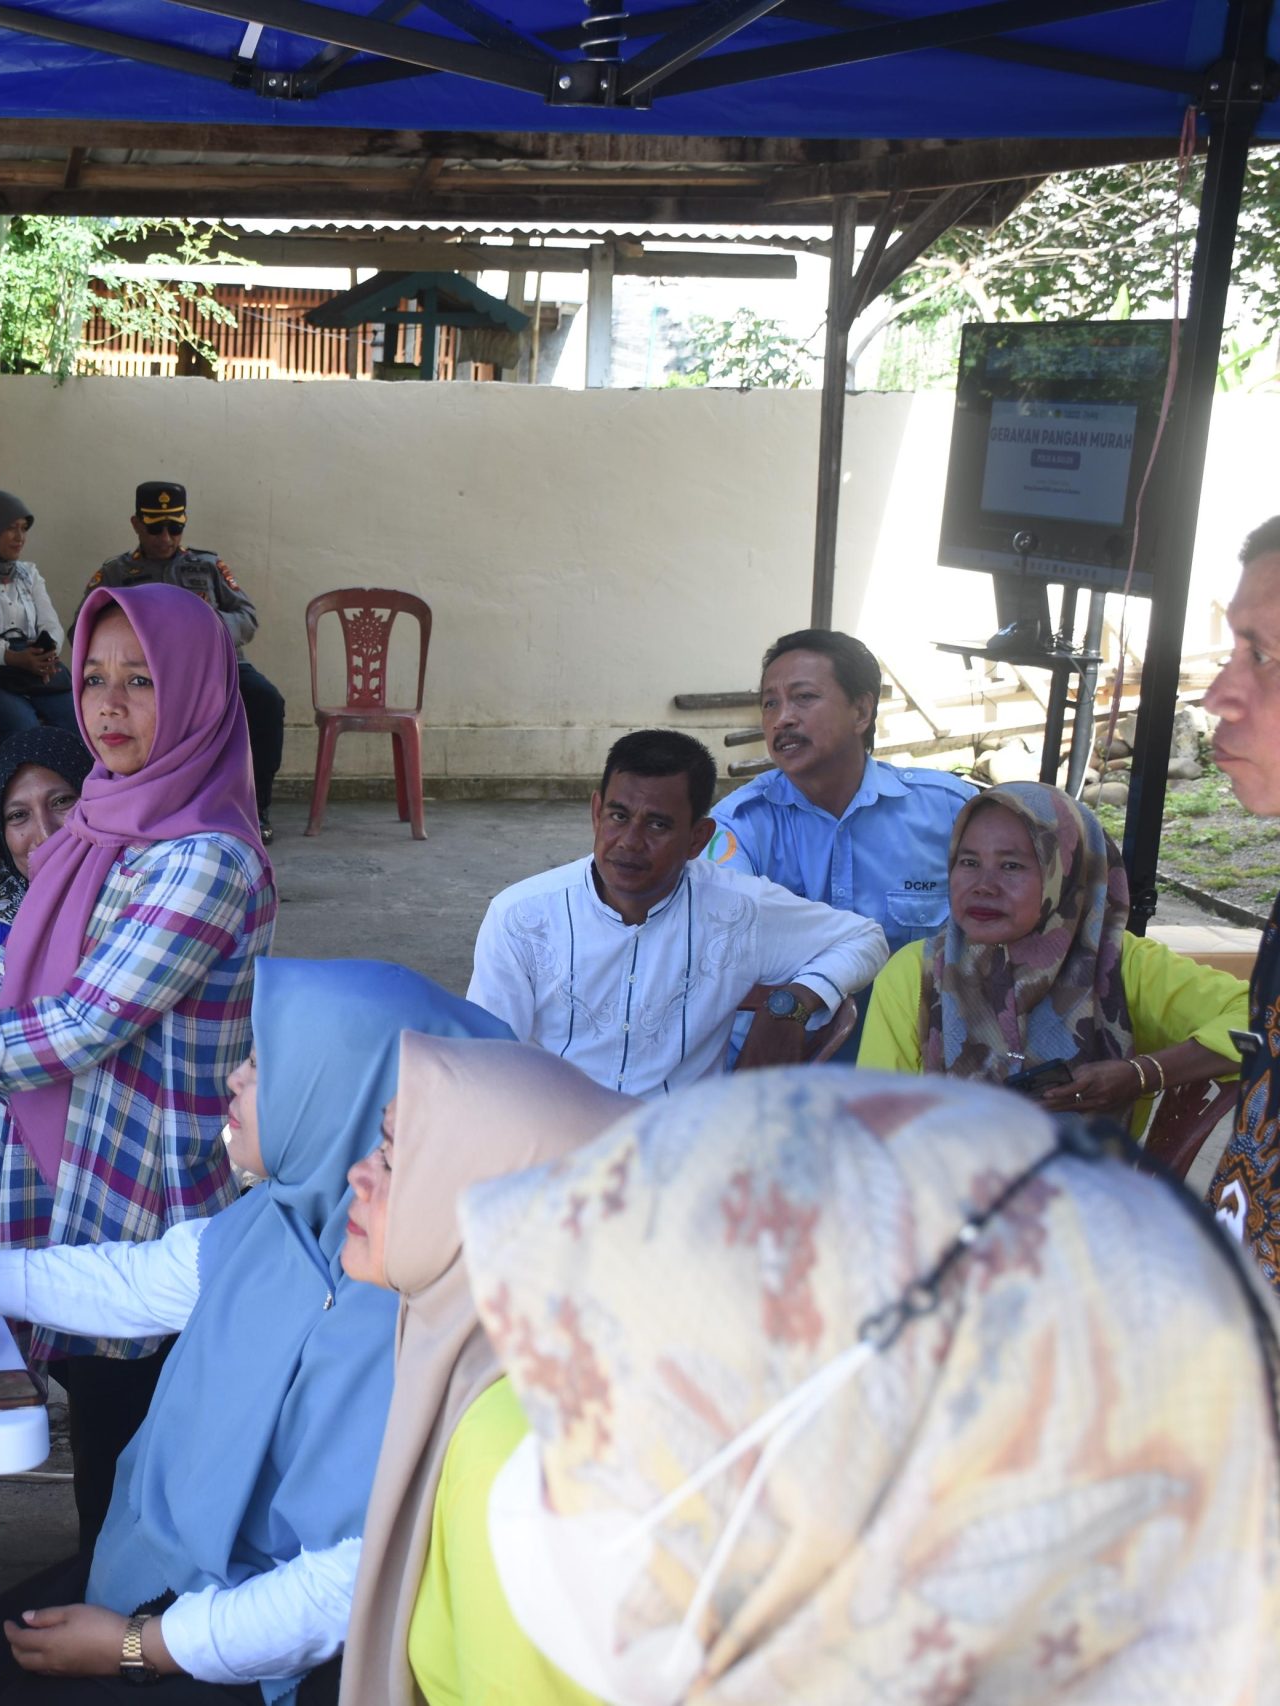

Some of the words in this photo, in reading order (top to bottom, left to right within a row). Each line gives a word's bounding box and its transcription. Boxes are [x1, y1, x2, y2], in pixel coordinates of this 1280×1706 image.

[1041, 430, 1087, 447] PANGAN
[1090, 432, 1133, 449] MURAH
[904, 881, 937, 891] DCKP
